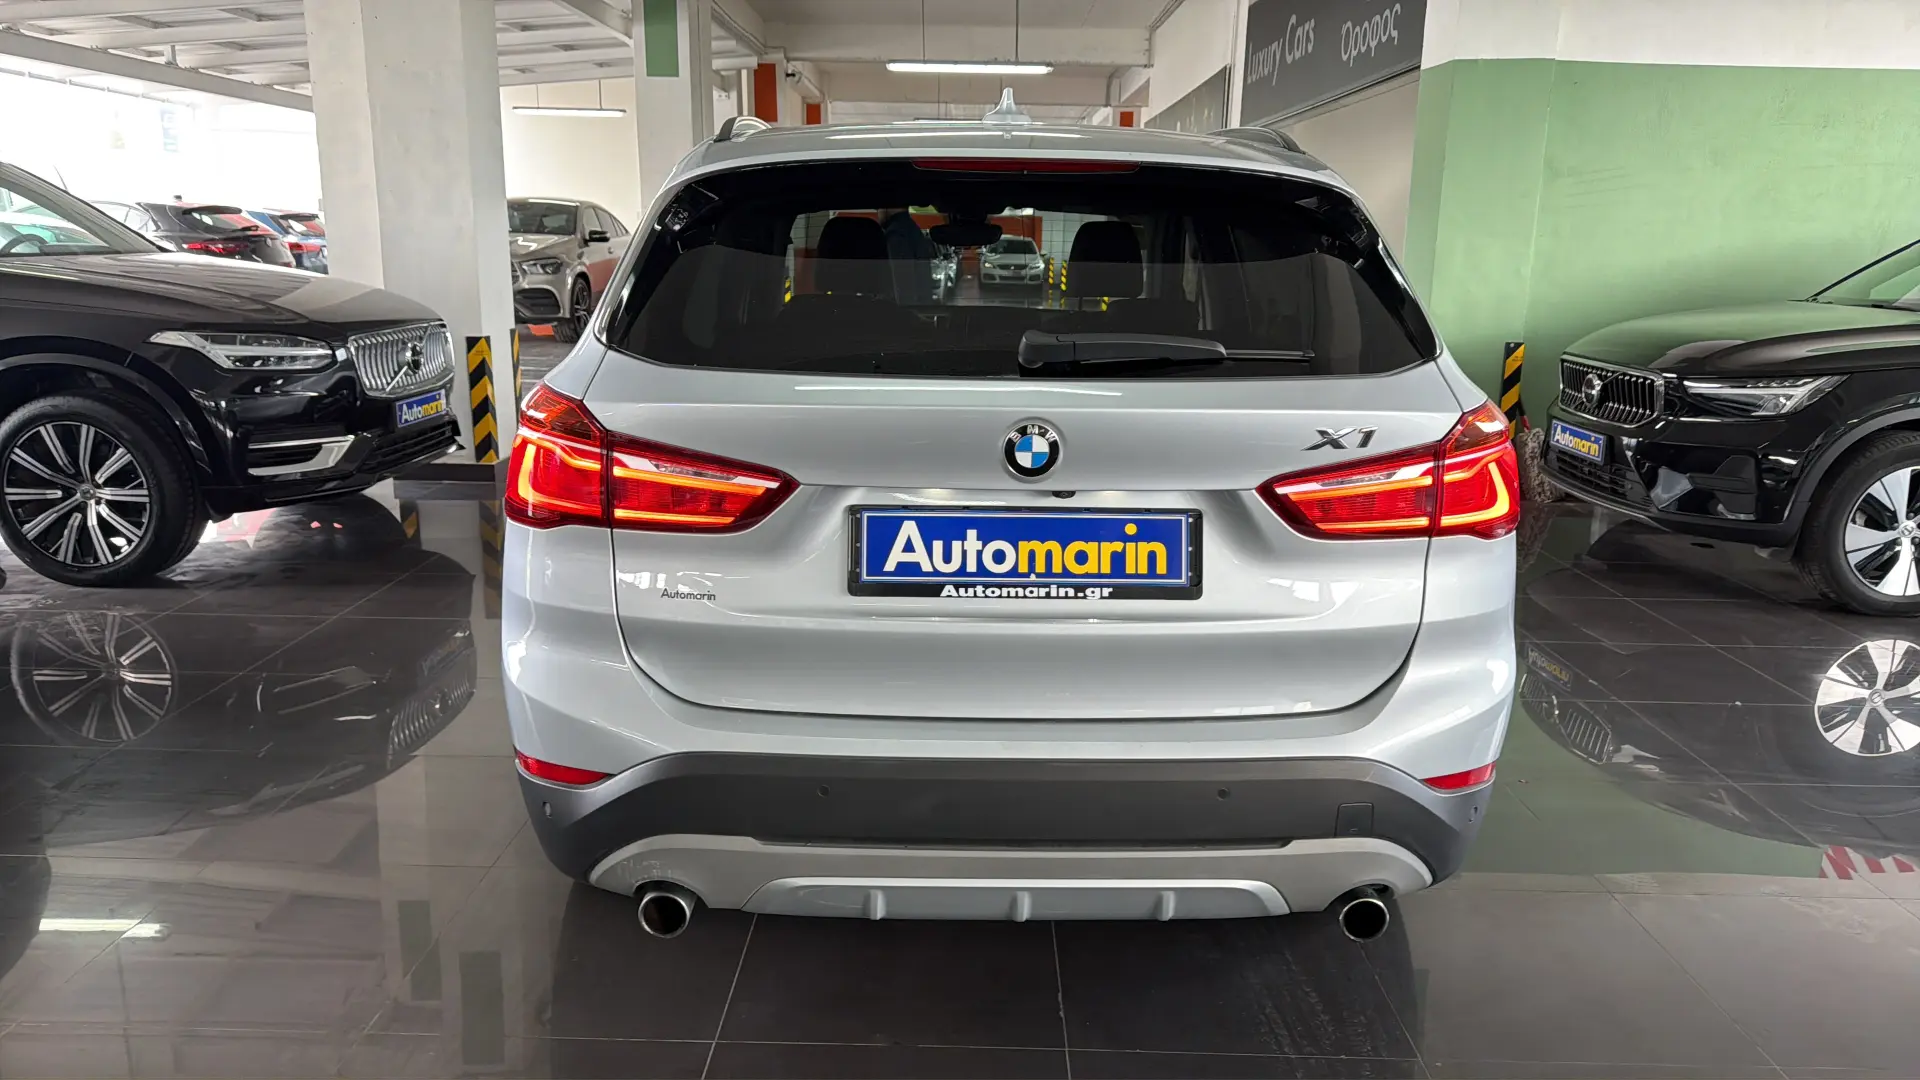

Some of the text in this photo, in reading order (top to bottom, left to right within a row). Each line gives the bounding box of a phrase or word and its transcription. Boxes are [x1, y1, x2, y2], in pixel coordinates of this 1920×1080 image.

[1247, 13, 1315, 87] Luxury Cars
[1009, 424, 1057, 443] BMW
[1300, 425, 1379, 451] X1
[1553, 424, 1600, 457] Automarin
[883, 520, 1168, 575] Automarin
[660, 587, 716, 601] Automarin
[940, 584, 1113, 600] Automarin.gr
